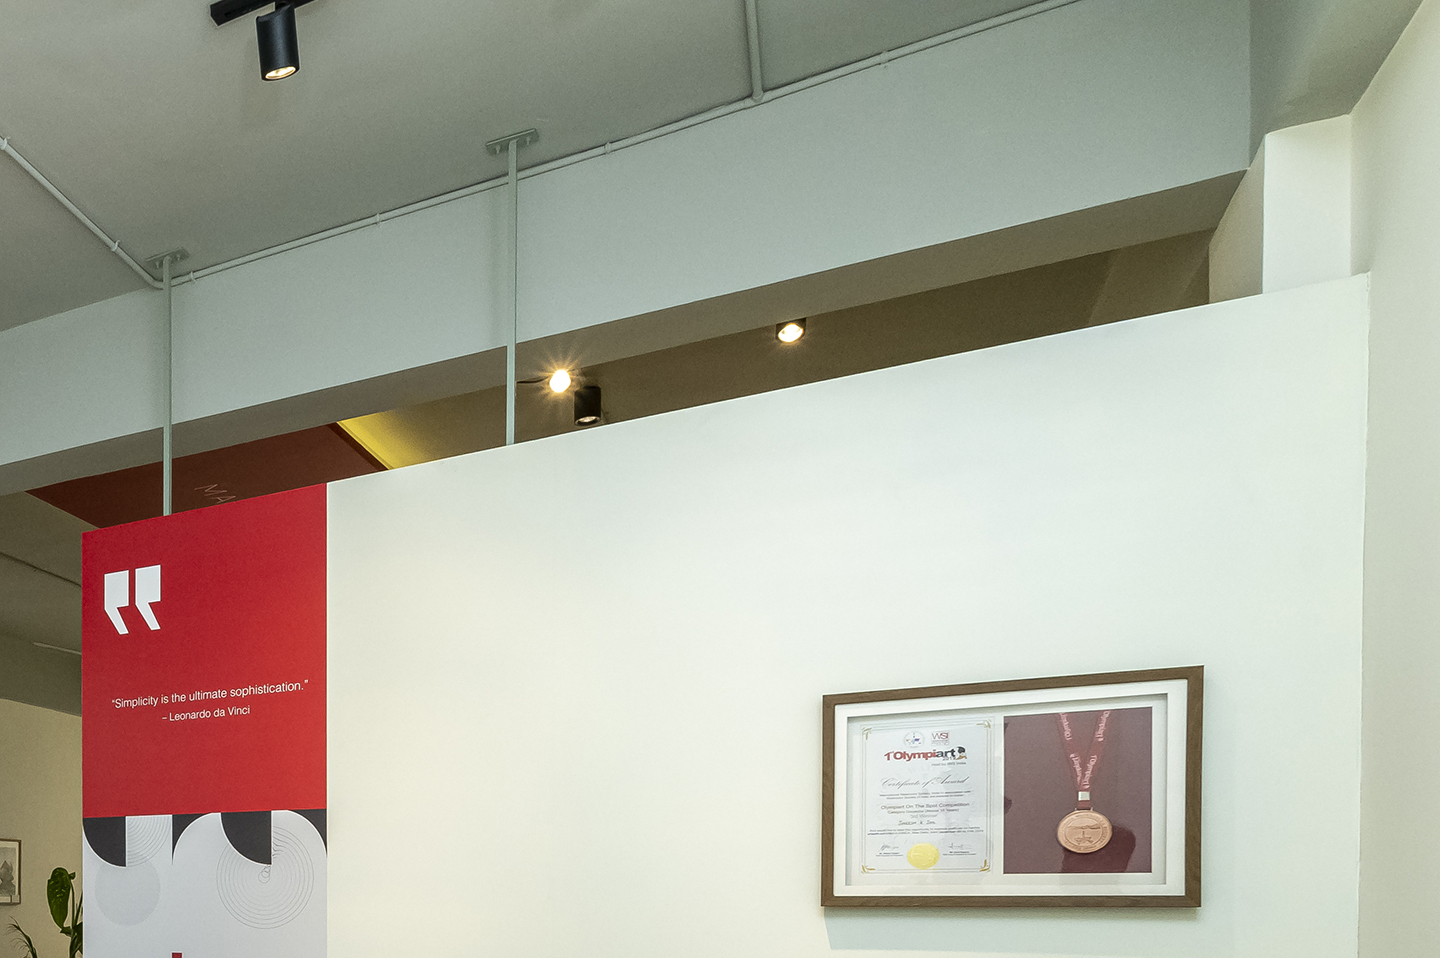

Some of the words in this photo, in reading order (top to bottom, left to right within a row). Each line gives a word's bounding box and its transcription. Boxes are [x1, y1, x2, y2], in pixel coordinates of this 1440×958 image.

[161, 695, 169, 704] is
[171, 693, 186, 703] the
[189, 689, 227, 702] ultimate
[169, 710, 211, 722] Leonardo
[213, 707, 226, 717] da
[227, 704, 251, 716] Vinci
